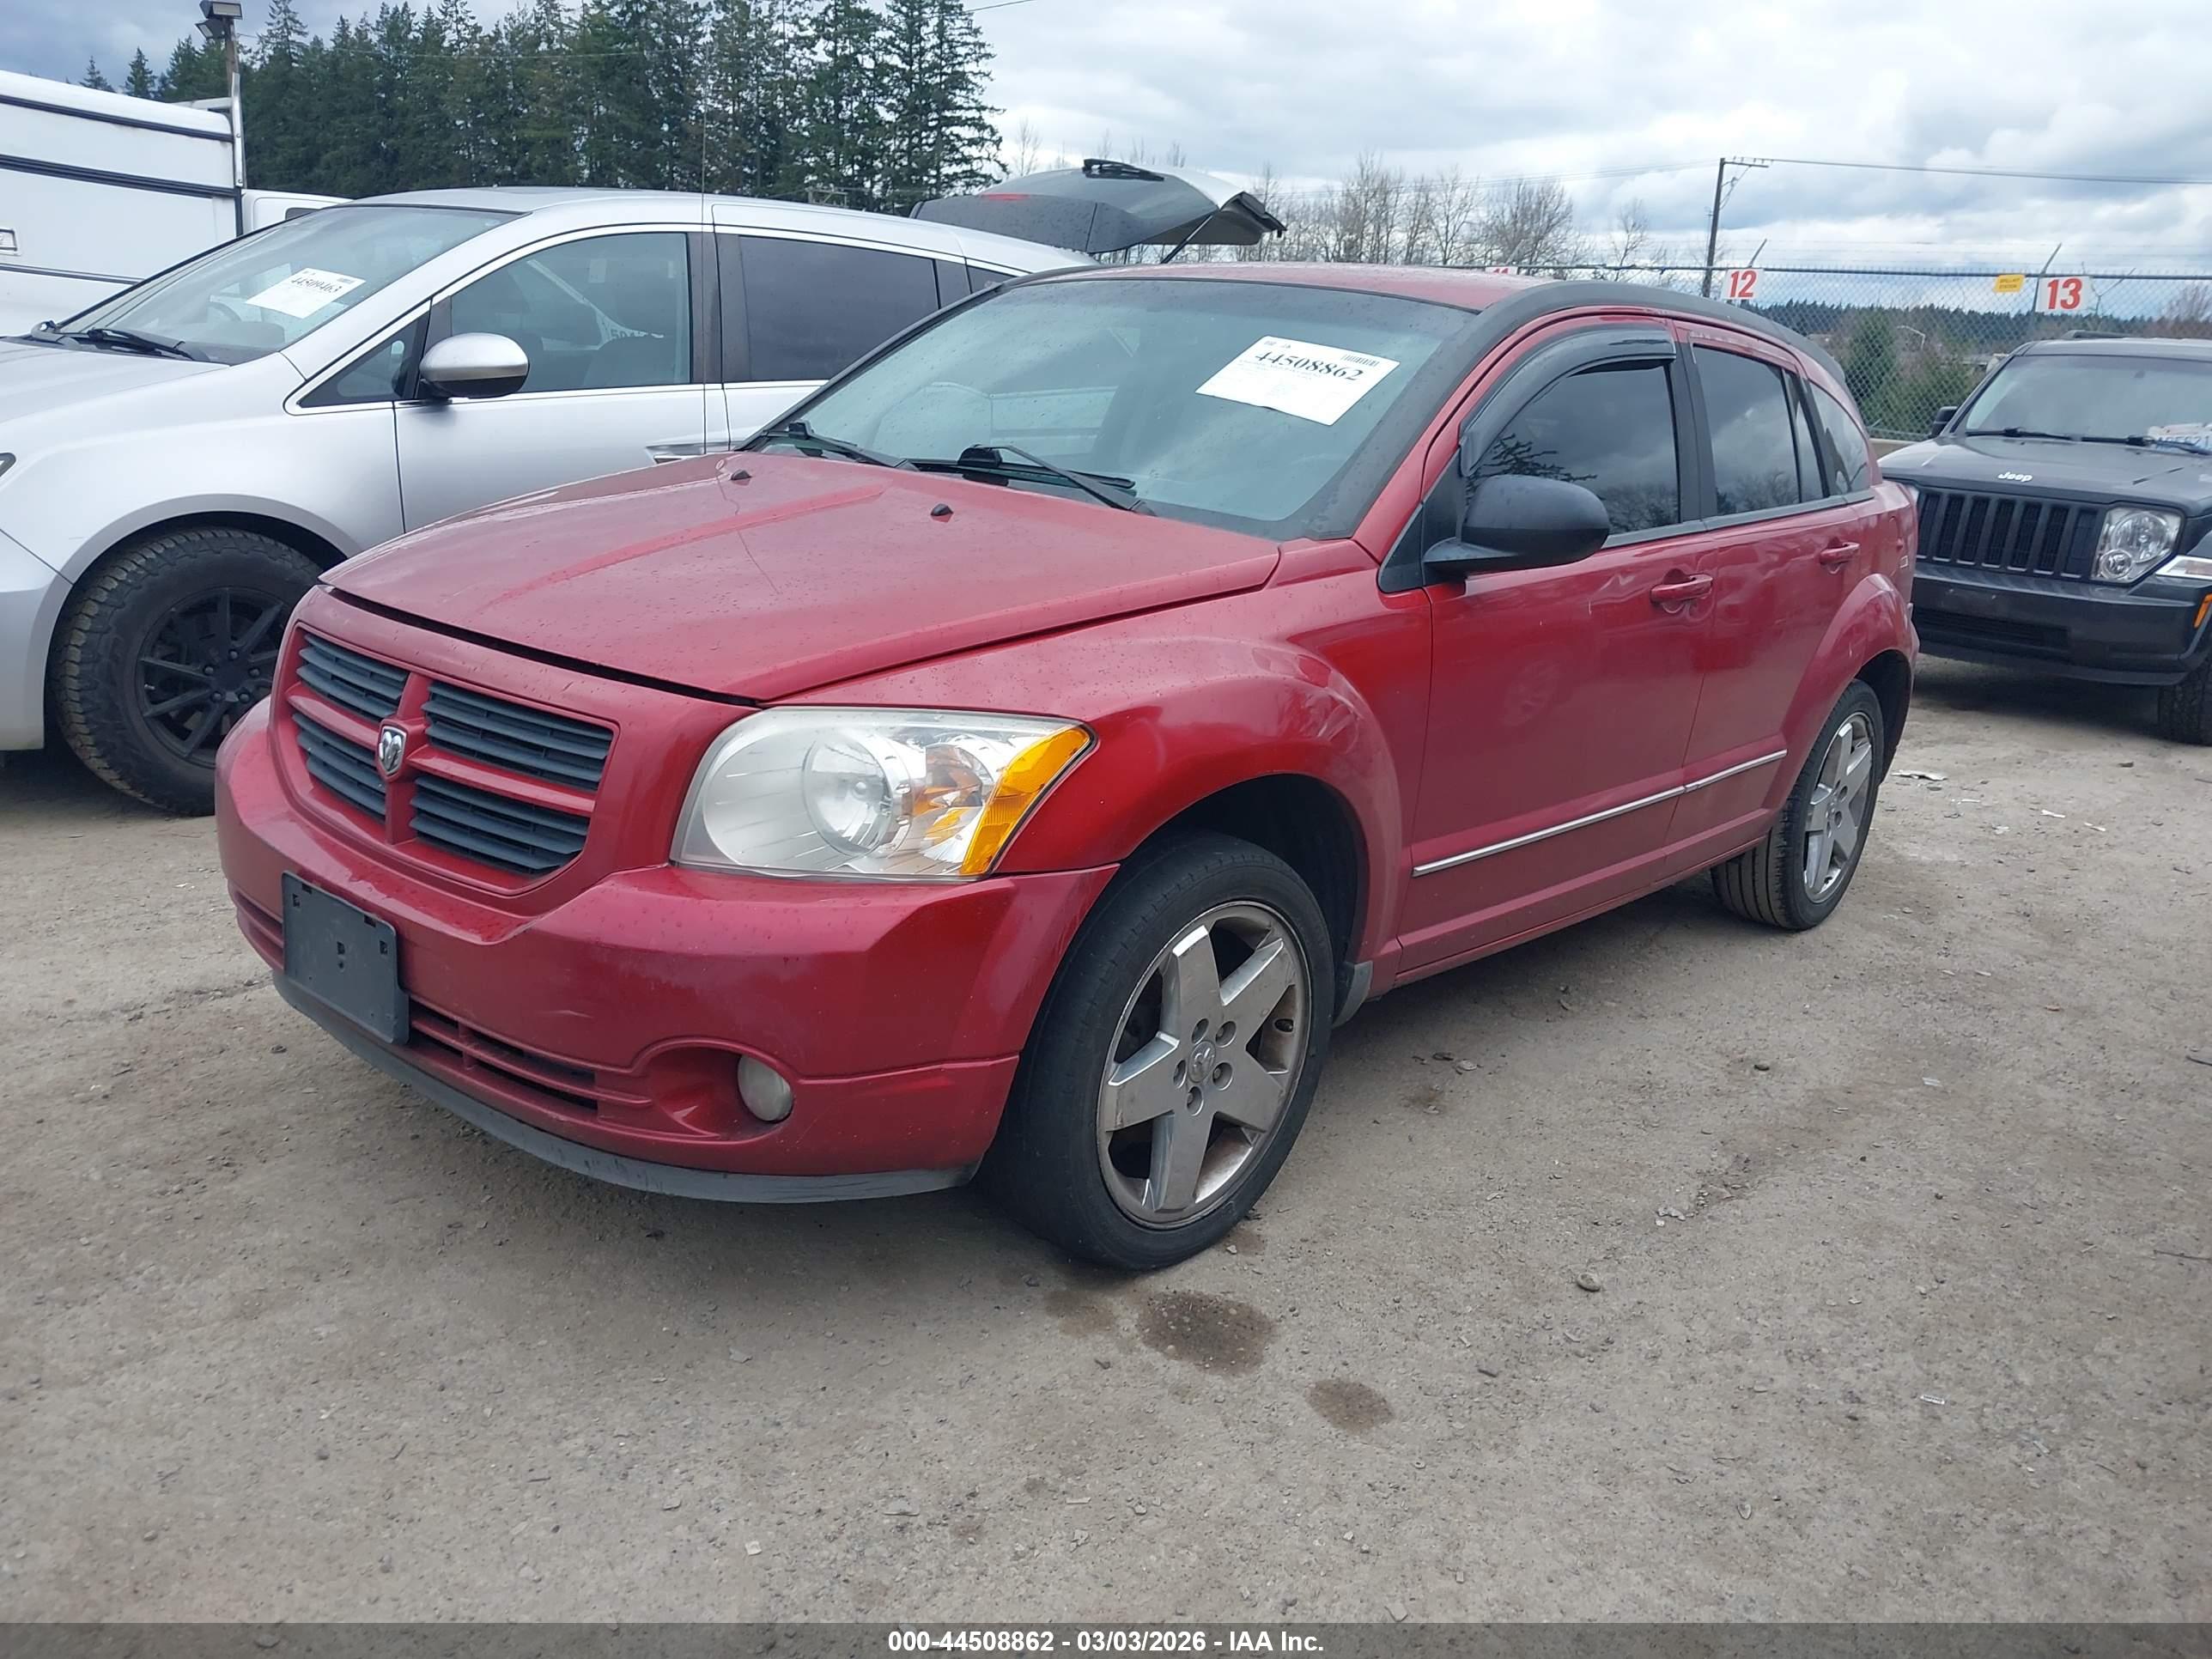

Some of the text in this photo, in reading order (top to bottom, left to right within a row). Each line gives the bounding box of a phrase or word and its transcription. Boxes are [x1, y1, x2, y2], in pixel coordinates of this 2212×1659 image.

[1730, 270, 1757, 298] 12
[2047, 277, 2082, 310] 13
[1255, 351, 1364, 380] 44508862
[1997, 471, 2033, 483] Jeep
